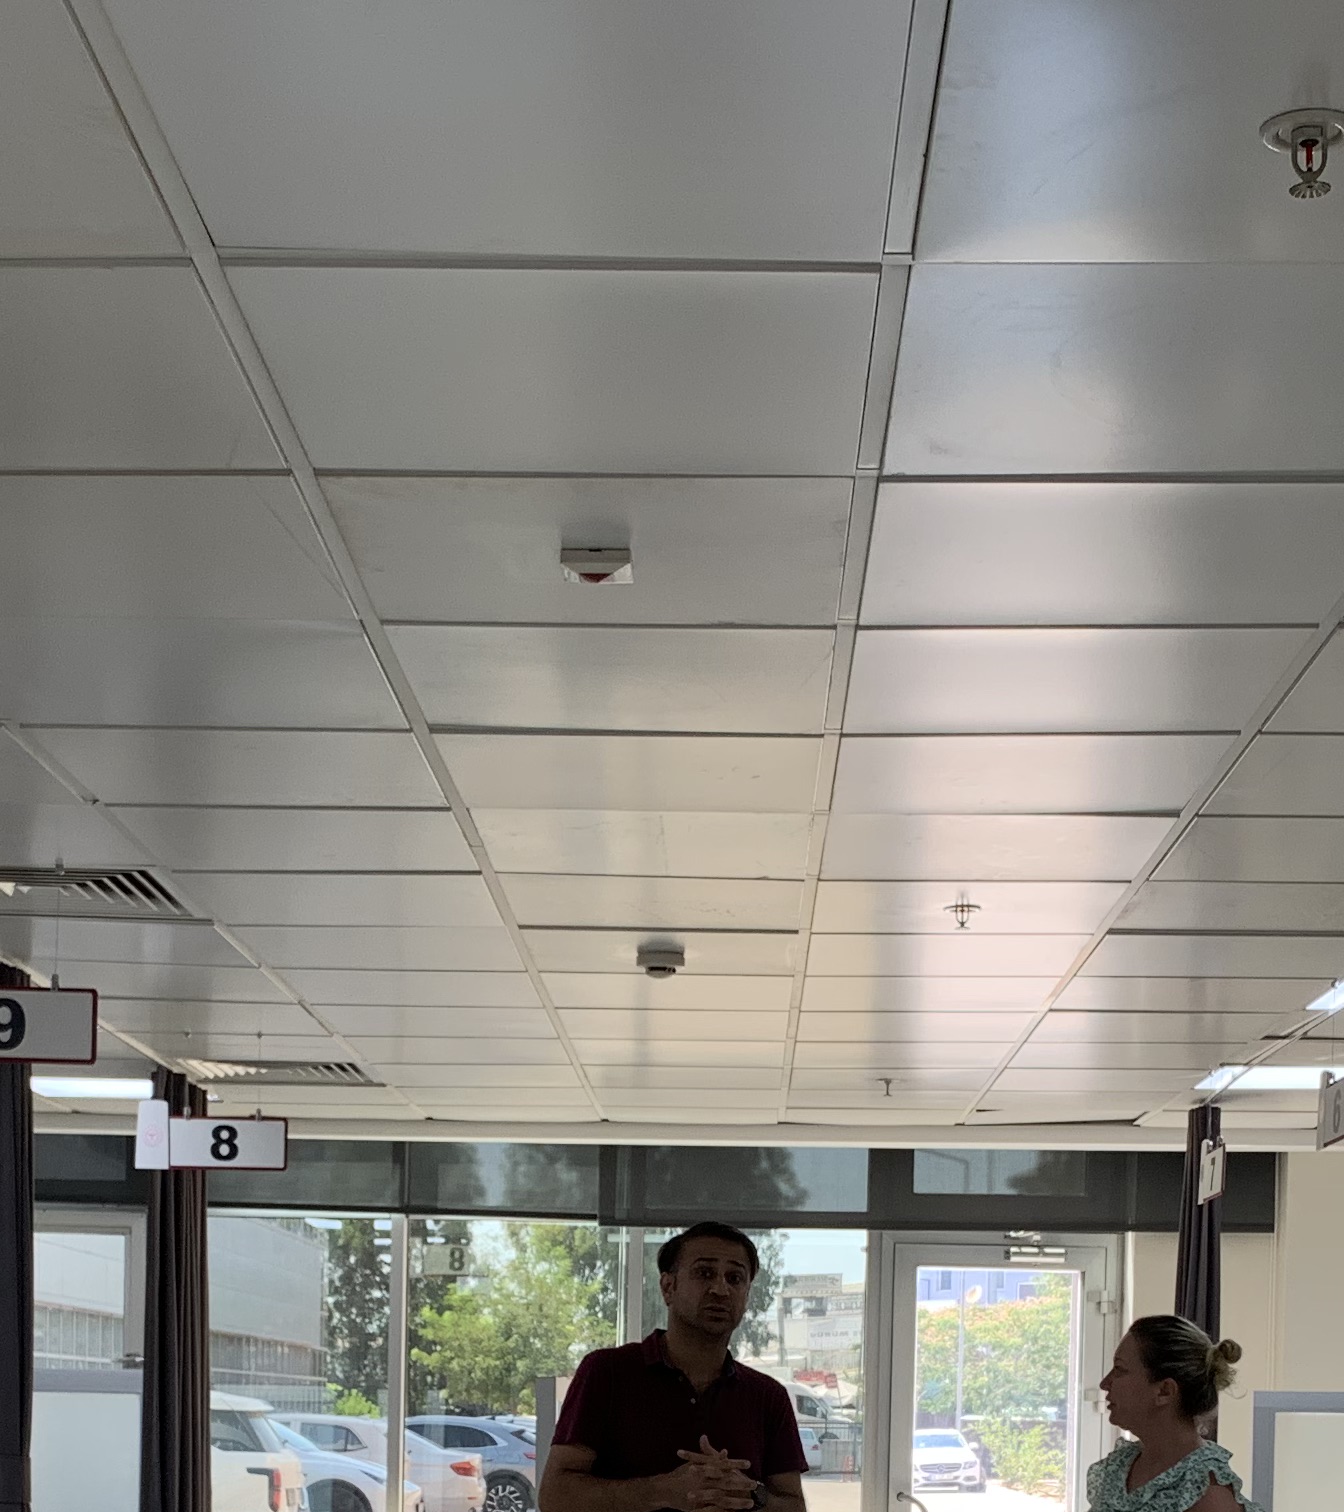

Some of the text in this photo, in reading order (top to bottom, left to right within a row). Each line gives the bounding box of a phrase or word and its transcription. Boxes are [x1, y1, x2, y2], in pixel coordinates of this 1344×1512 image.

[1333, 1088, 1342, 1134] 6
[210, 1125, 239, 1161] 8
[1210, 1156, 1216, 1191] 7
